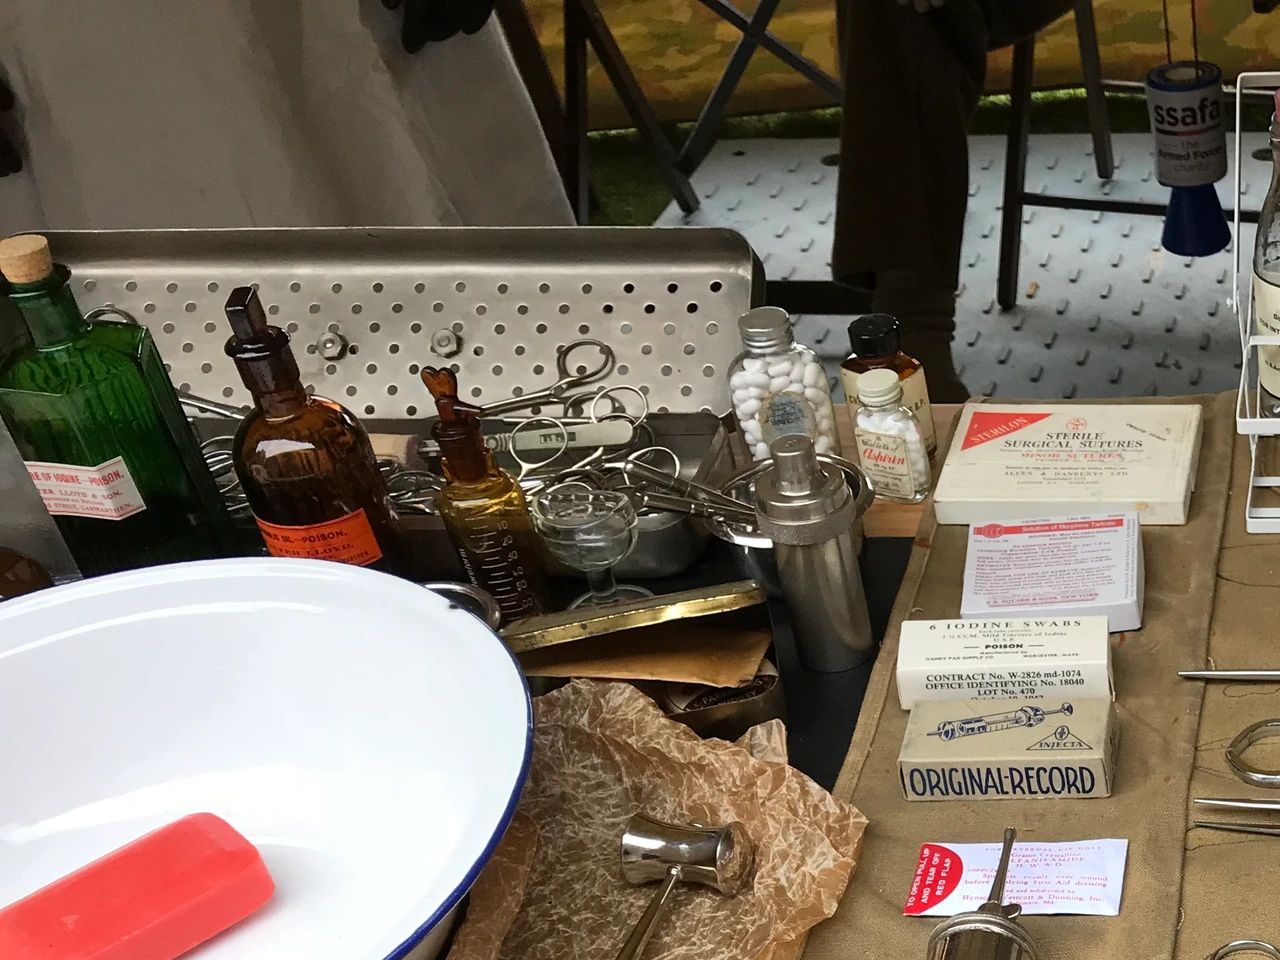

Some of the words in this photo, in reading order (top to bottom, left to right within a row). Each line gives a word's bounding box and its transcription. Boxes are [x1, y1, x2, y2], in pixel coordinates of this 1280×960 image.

[1154, 97, 1220, 127] ssafa
[970, 415, 1029, 444] STERILON
[1045, 431, 1104, 440] STERILE
[1003, 439, 1073, 449] SURGICAL
[1079, 439, 1144, 449] SUTURES
[862, 448, 906, 466] Aspirin
[301, 529, 349, 544] POISON.
[946, 621, 1015, 631] IODINE
[1022, 619, 1083, 628] SWABS
[926, 672, 987, 682] CONTRACT
[988, 671, 1006, 681] No.
[1007, 671, 1042, 680] W-2826
[1043, 669, 1082, 679] md-1074
[925, 680, 965, 690] OFFICE
[966, 679, 1038, 690] IDENTIFYING
[1040, 678, 1057, 688] No.
[1059, 677, 1085, 687] 18040
[976, 688, 999, 697] LOT
[1001, 688, 1018, 696] No.
[1018, 687, 1036, 695] 470
[1038, 741, 1084, 749] INJECTA
[909, 766, 1096, 797] ORIGINAL-RECORD
[922, 848, 930, 858] UP
[931, 852, 941, 865] OFF
[916, 858, 928, 875] PULL
[940, 857, 952, 877] FLAP
[925, 866, 937, 885] TEAR
[910, 876, 922, 896] OPEN
[935, 879, 946, 896] RED
[907, 896, 916, 907] TO
[920, 887, 931, 904] AND
